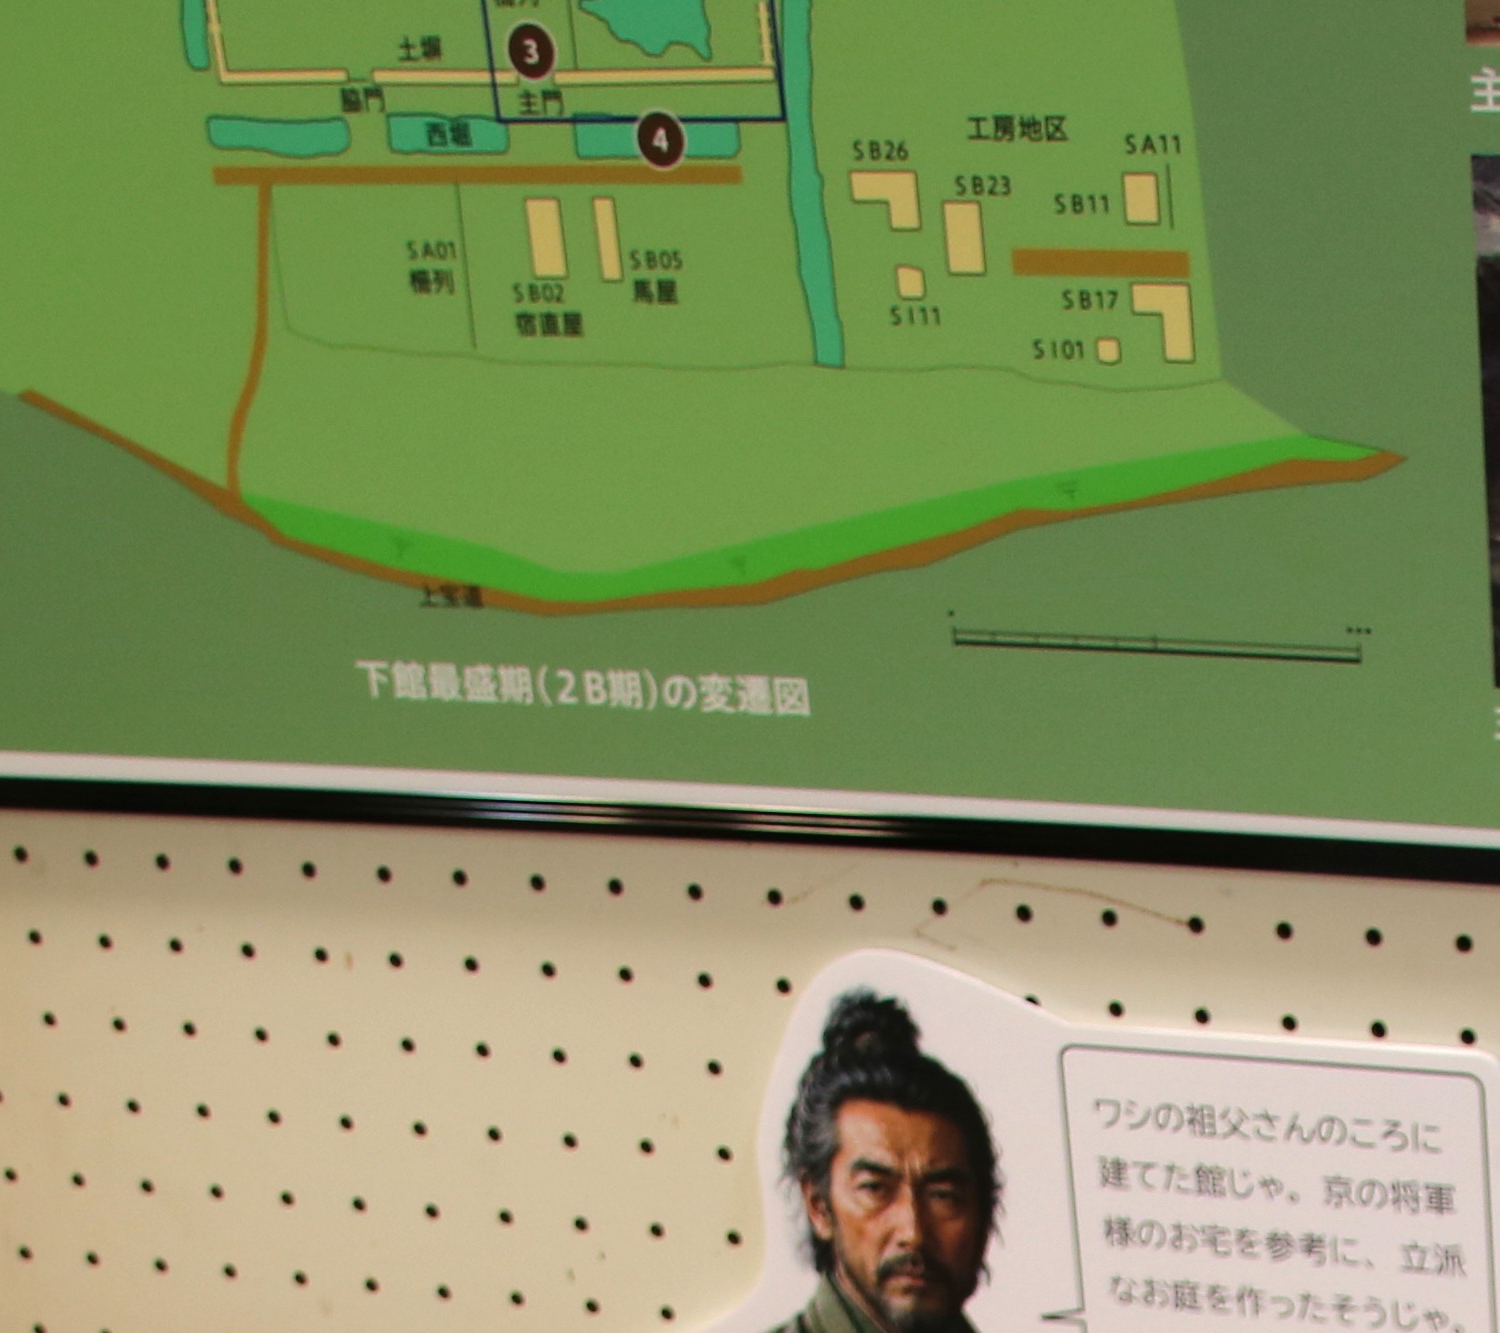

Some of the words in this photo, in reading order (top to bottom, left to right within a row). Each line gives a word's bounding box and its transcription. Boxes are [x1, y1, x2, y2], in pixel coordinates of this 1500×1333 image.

[518, 89, 565, 116] 主門
[966, 114, 1069, 143] 工房地区
[1094, 1097, 1443, 1155] ワシの祖父さんのころに
